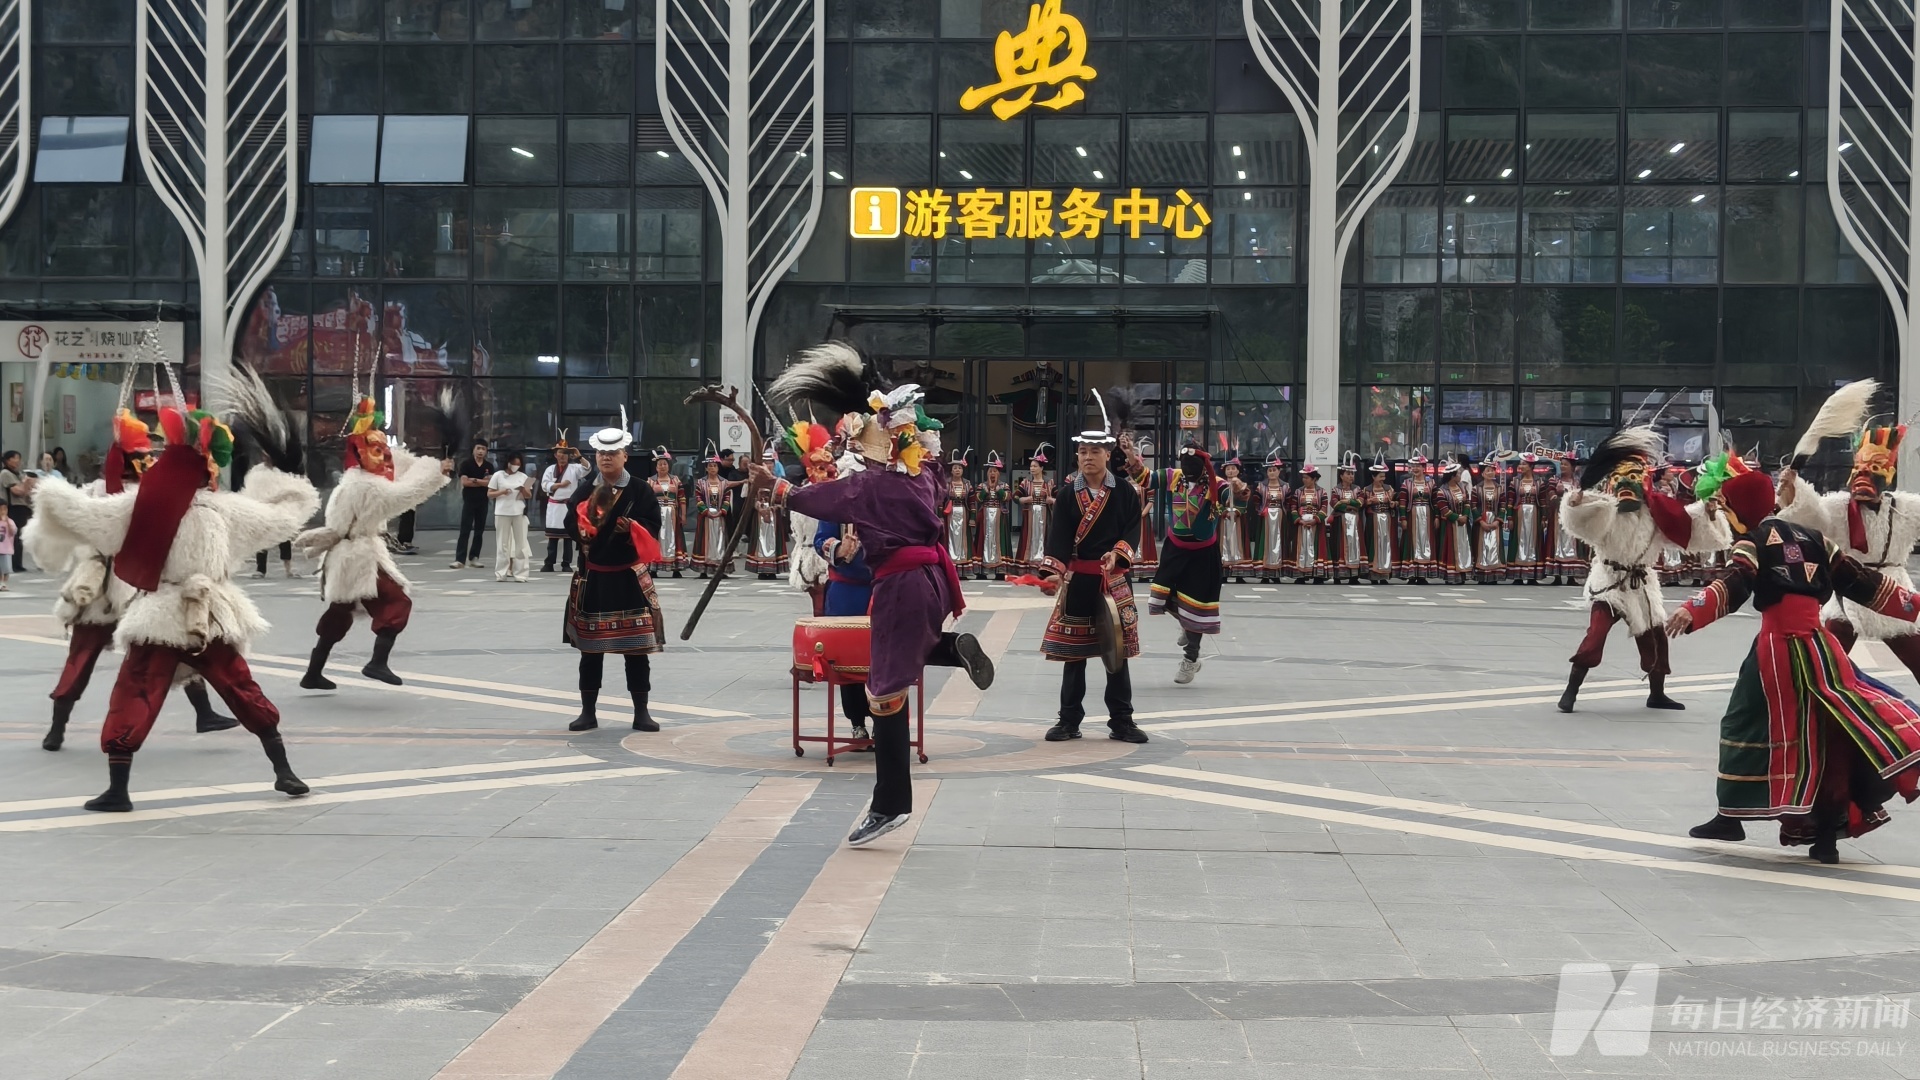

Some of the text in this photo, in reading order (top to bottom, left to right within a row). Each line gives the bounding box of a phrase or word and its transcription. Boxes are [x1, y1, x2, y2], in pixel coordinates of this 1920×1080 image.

[959, 0, 1097, 120] 典
[904, 187, 1212, 239] 游客服务中心
